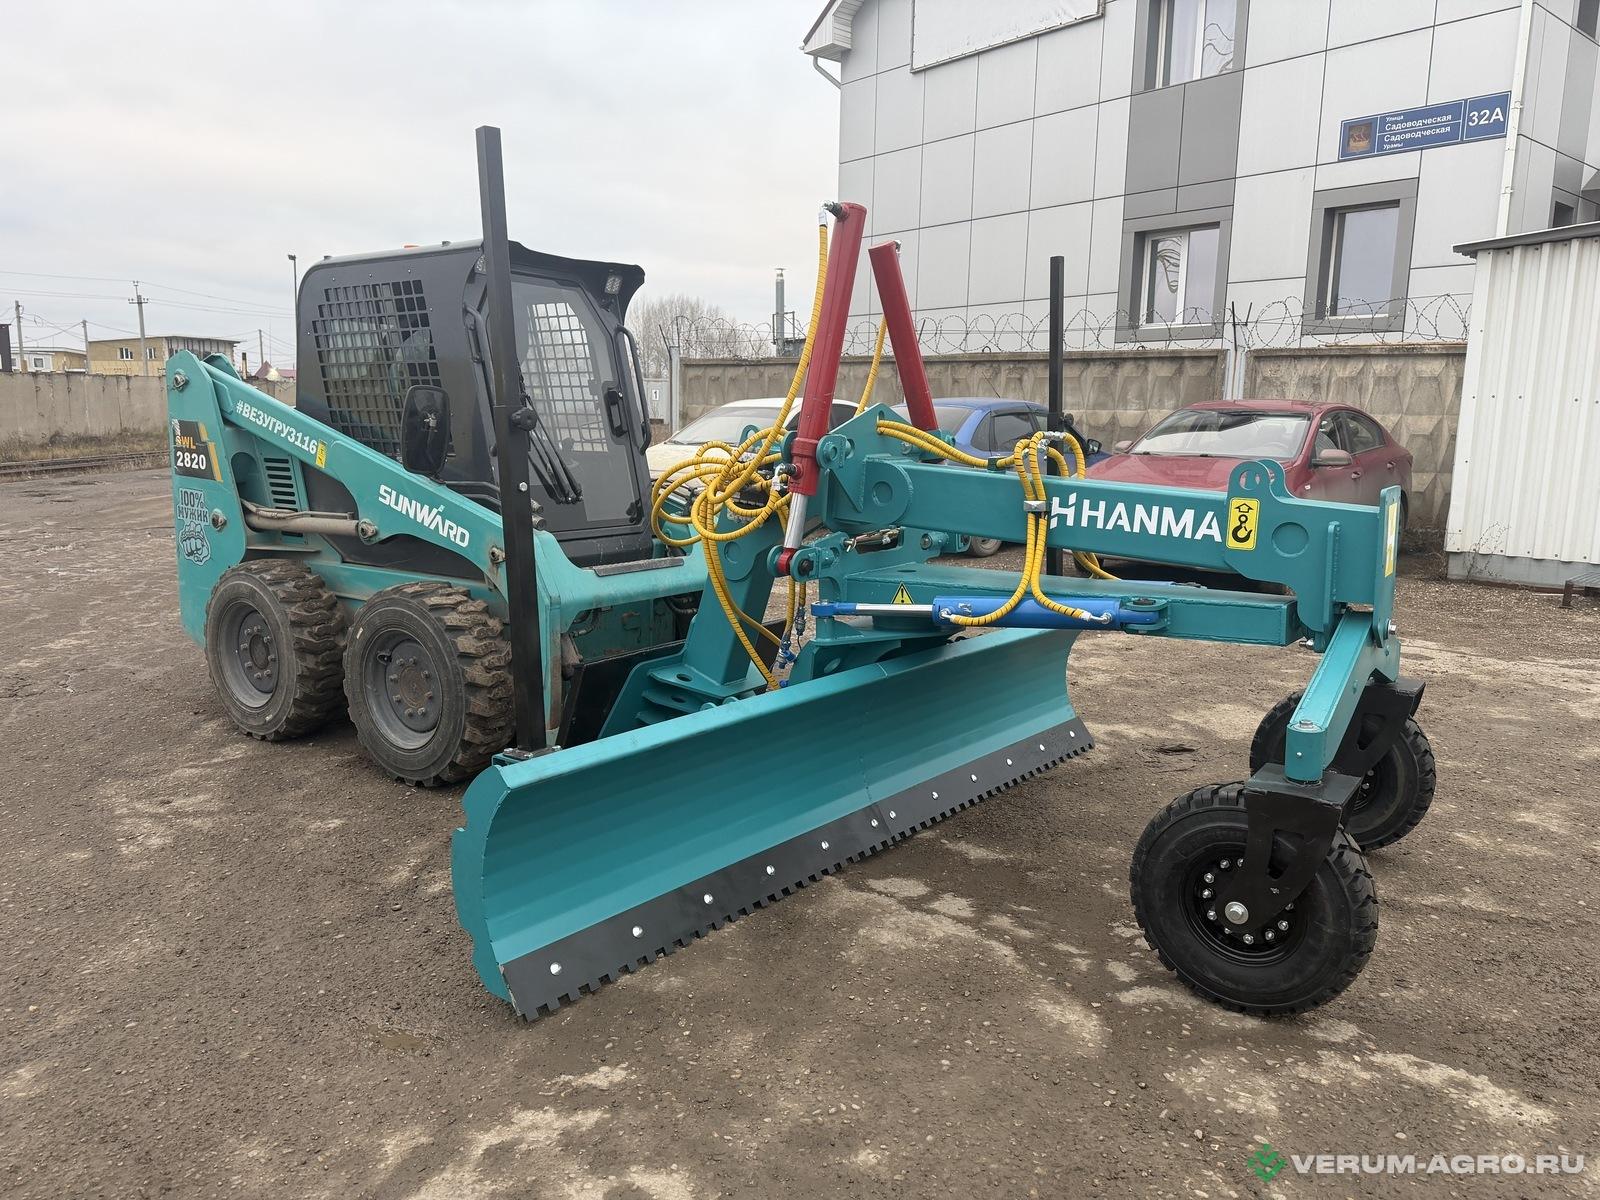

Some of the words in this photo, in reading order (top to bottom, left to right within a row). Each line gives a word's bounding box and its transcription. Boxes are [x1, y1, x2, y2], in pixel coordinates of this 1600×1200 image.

[1385, 114, 1452, 131] Садоводческая
[1384, 126, 1451, 142] Садоводческая
[176, 451, 207, 470] 2820
[180, 489, 205, 509] 100%
[177, 505, 209, 523] МУЖИК
[378, 484, 470, 548] SUNWARD
